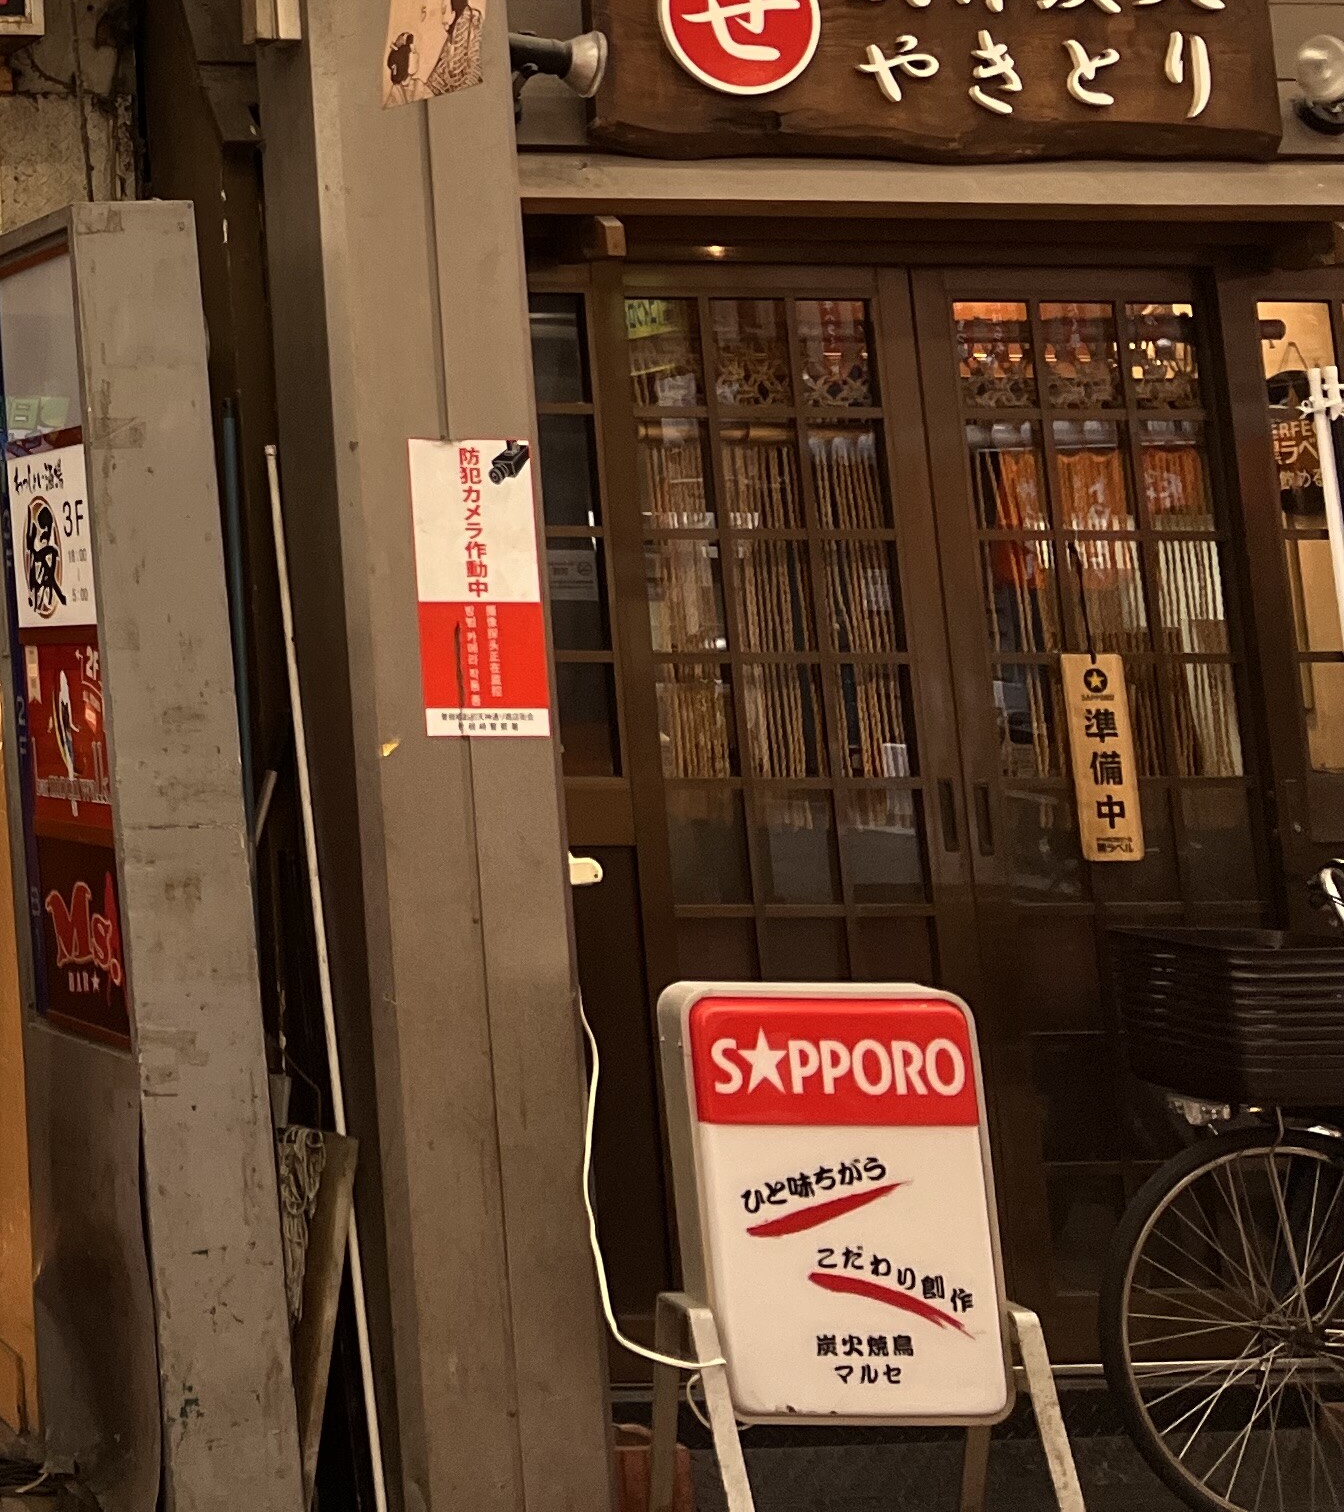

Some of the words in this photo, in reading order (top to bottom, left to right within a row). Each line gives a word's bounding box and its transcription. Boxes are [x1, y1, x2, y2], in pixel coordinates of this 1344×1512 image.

[855, 30, 1213, 118] やきとり
[63, 499, 84, 538] 3F
[459, 448, 488, 597] 防犯カメラ作動中
[1085, 709, 1125, 829] 準備中
[742, 1157, 887, 1214] ひと味ちがう
[817, 1246, 973, 1314] こだわり創作
[816, 1335, 914, 1356] 炭火焼鳥
[834, 1365, 902, 1385] マルセ
